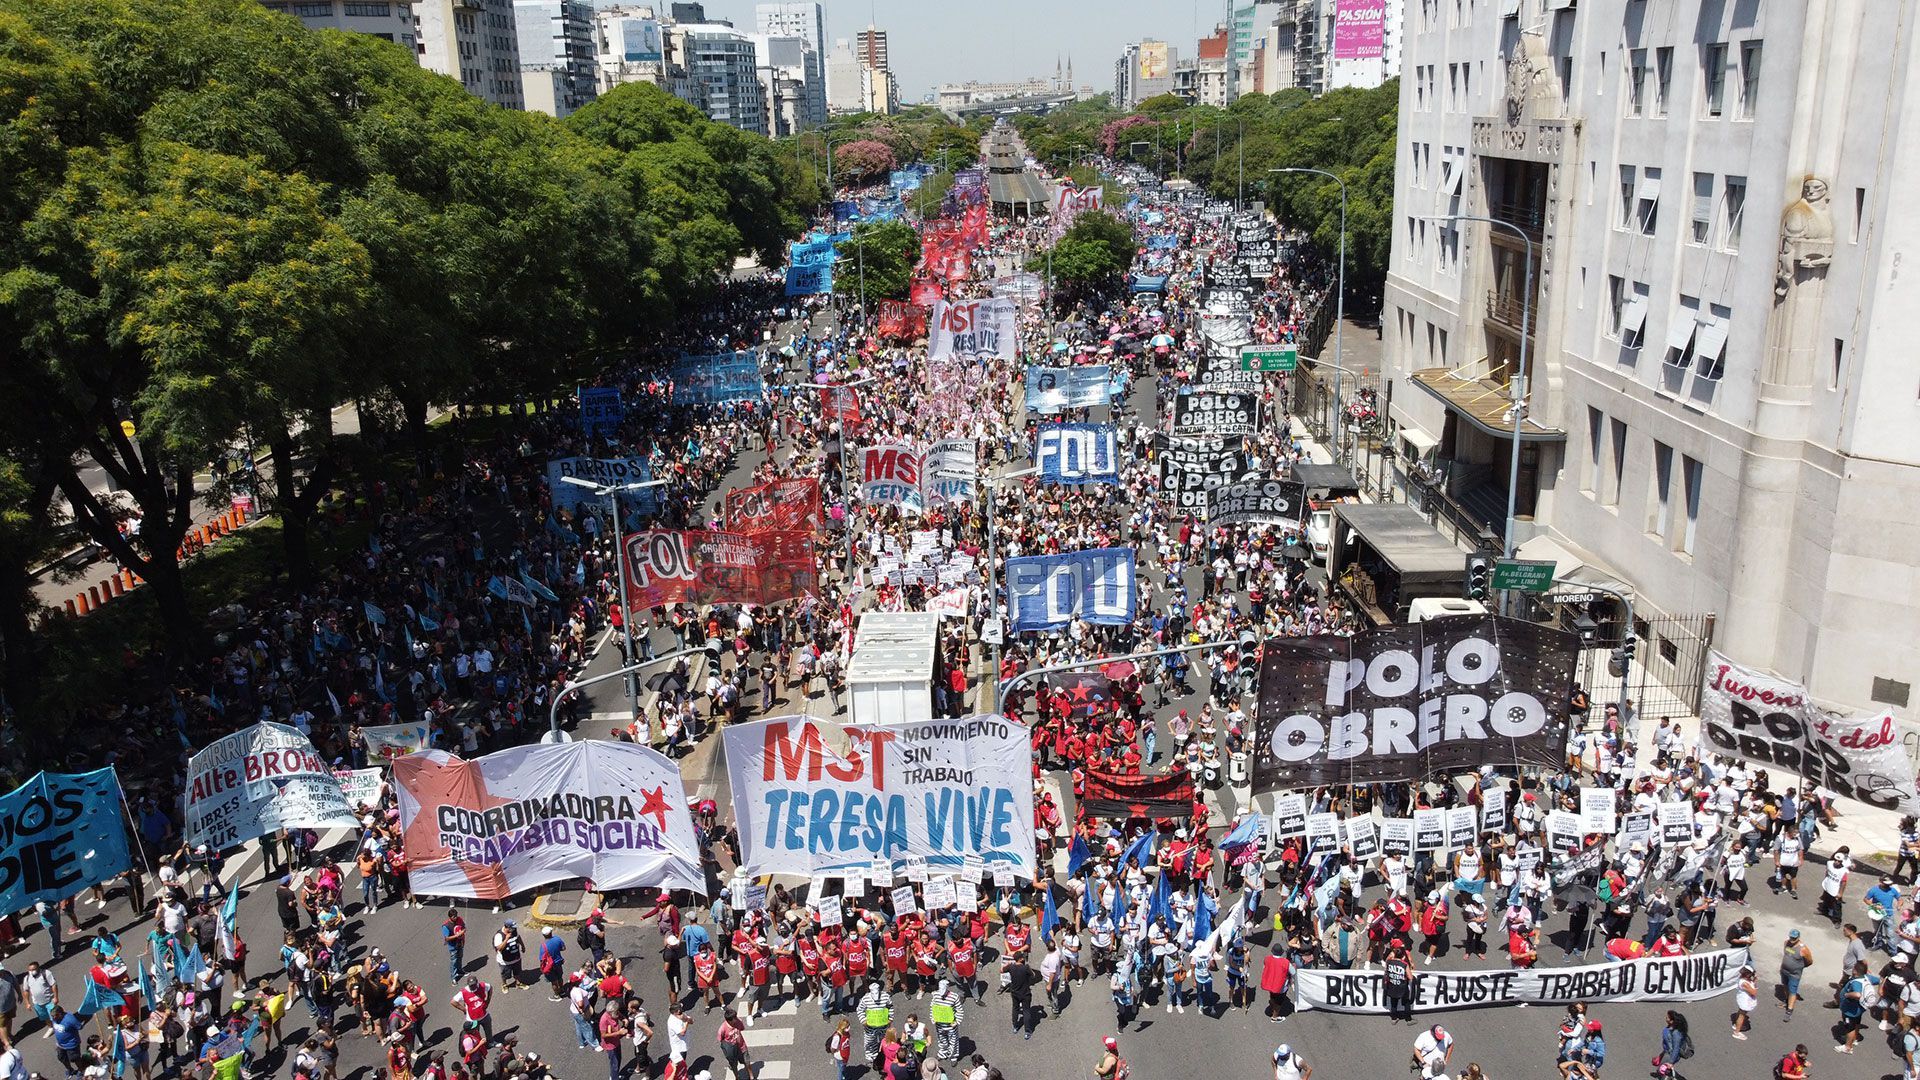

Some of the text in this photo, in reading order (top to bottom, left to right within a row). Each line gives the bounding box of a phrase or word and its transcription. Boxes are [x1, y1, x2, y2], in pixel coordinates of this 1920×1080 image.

[1338, 6, 1383, 20] PASIÓN
[1242, 241, 1270, 250] POLO
[1238, 257, 1268, 265] POLO
[1210, 291, 1244, 301] POLO
[1202, 371, 1262, 383] OBRERO
[1188, 395, 1240, 411] POLO
[1181, 410, 1248, 425] OBRERO
[1169, 437, 1224, 453] POLO
[561, 459, 642, 478] BARRIOS
[929, 460, 940, 469] SIN
[1216, 482, 1281, 502] POLO
[731, 491, 773, 522] FOL
[1208, 497, 1289, 519] OBRERO
[711, 534, 744, 546] FRENTE
[701, 543, 765, 557] ORGANIZACIONES
[625, 531, 697, 588] FOL
[714, 554, 757, 567] EN LUCHA
[1554, 594, 1594, 603] MORENO
[1325, 638, 1500, 706] POLO
[903, 720, 1009, 744] MOVIMIENTO
[1271, 692, 1546, 762] OBRERO
[1840, 716, 1894, 750] del
[763, 722, 895, 791] MST
[903, 746, 932, 764] SIN
[903, 767, 973, 787] TRABAJO
[190, 768, 242, 805] Alte.
[308, 785, 319, 793] NO
[323, 785, 332, 793] SE
[1355, 789, 1367, 800] 14
[316, 801, 326, 809] SE
[193, 796, 240, 835] LIBRES
[437, 794, 636, 838] COORDINADORA
[764, 788, 908, 860] TERESA
[925, 786, 1014, 852] VIVE
[209, 819, 231, 836] DEL
[204, 826, 240, 850] SUR
[440, 833, 464, 849] POR
[464, 818, 666, 867] CAMBIO SOCIAL
[452, 849, 465, 861] EL
[1008, 934, 1024, 946] MST
[849, 953, 867, 963] MST
[888, 947, 906, 958] MST
[954, 952, 972, 963] MST
[1326, 974, 1388, 1007] BAST
[1433, 973, 1518, 1003] AJUSTE
[1538, 963, 1636, 999] TRABAJO
[1644, 954, 1728, 995] GENUINO
